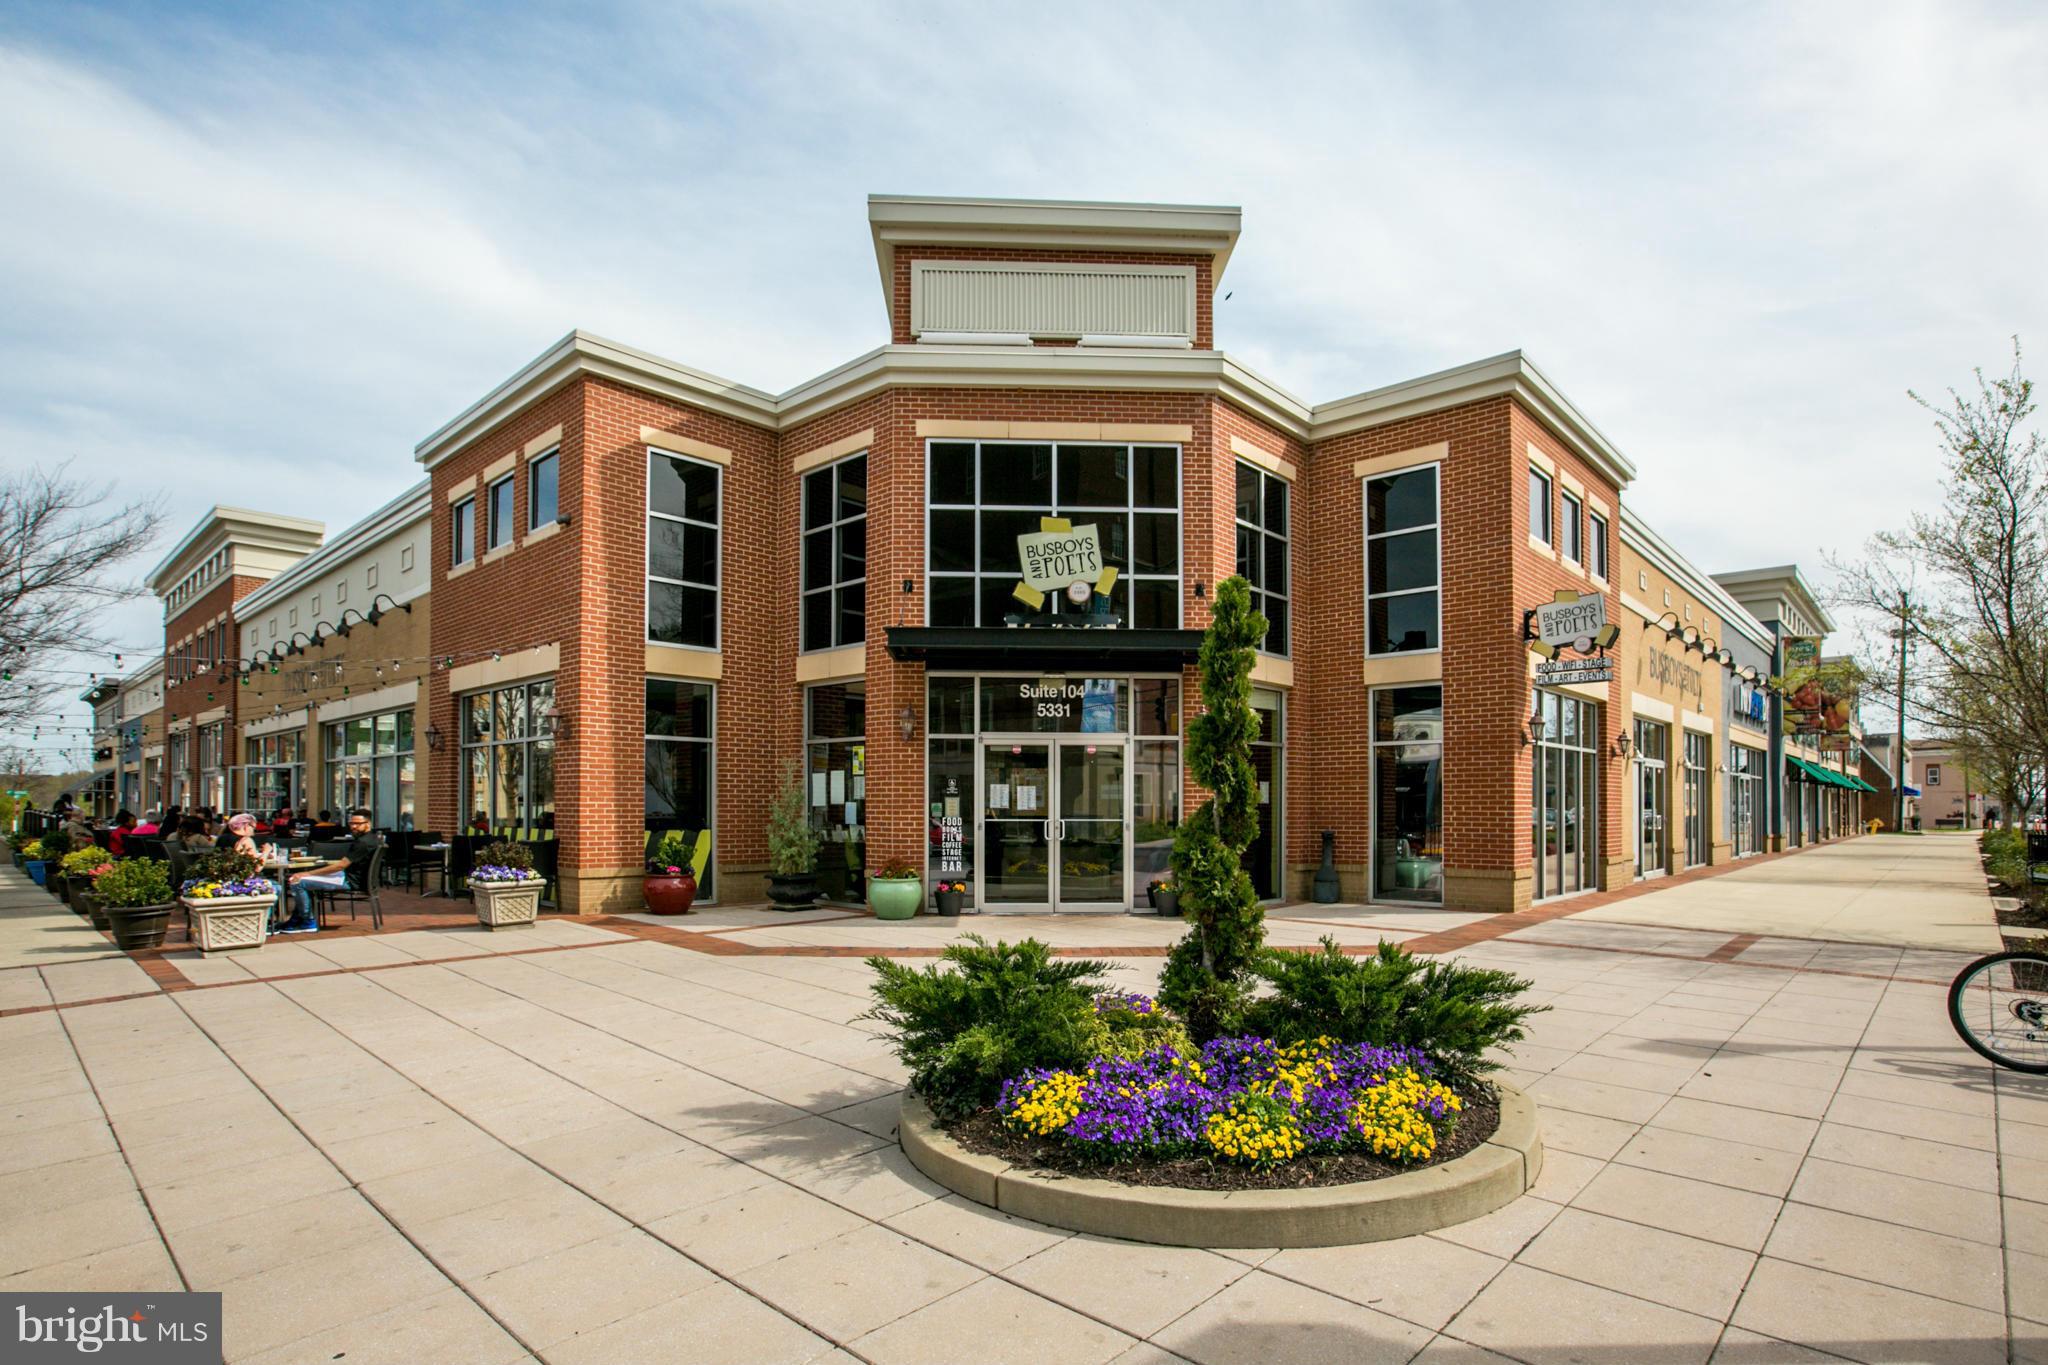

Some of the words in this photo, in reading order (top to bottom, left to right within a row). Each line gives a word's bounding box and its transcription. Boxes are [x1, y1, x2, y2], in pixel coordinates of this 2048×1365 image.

[1027, 537, 1094, 559] BUSBOYS
[1030, 559, 1043, 579] AND
[1042, 551, 1097, 579] POETS
[1543, 603, 1596, 623] BUSBOYS
[1555, 613, 1597, 636] POETS
[1537, 663, 1557, 672] FOOD
[1562, 660, 1577, 670] WIFI
[1583, 659, 1606, 669] STAGE
[1537, 674, 1554, 684] FILM
[1559, 673, 1573, 682] ART
[1579, 671, 1606, 681] EVENTS
[1020, 684, 1058, 698] Suite
[1061, 685, 1085, 698] 104
[1037, 703, 1071, 718] 5331
[942, 817, 962, 826] FOOD
[942, 833, 962, 842] FILM
[942, 861, 962, 872] BAR
